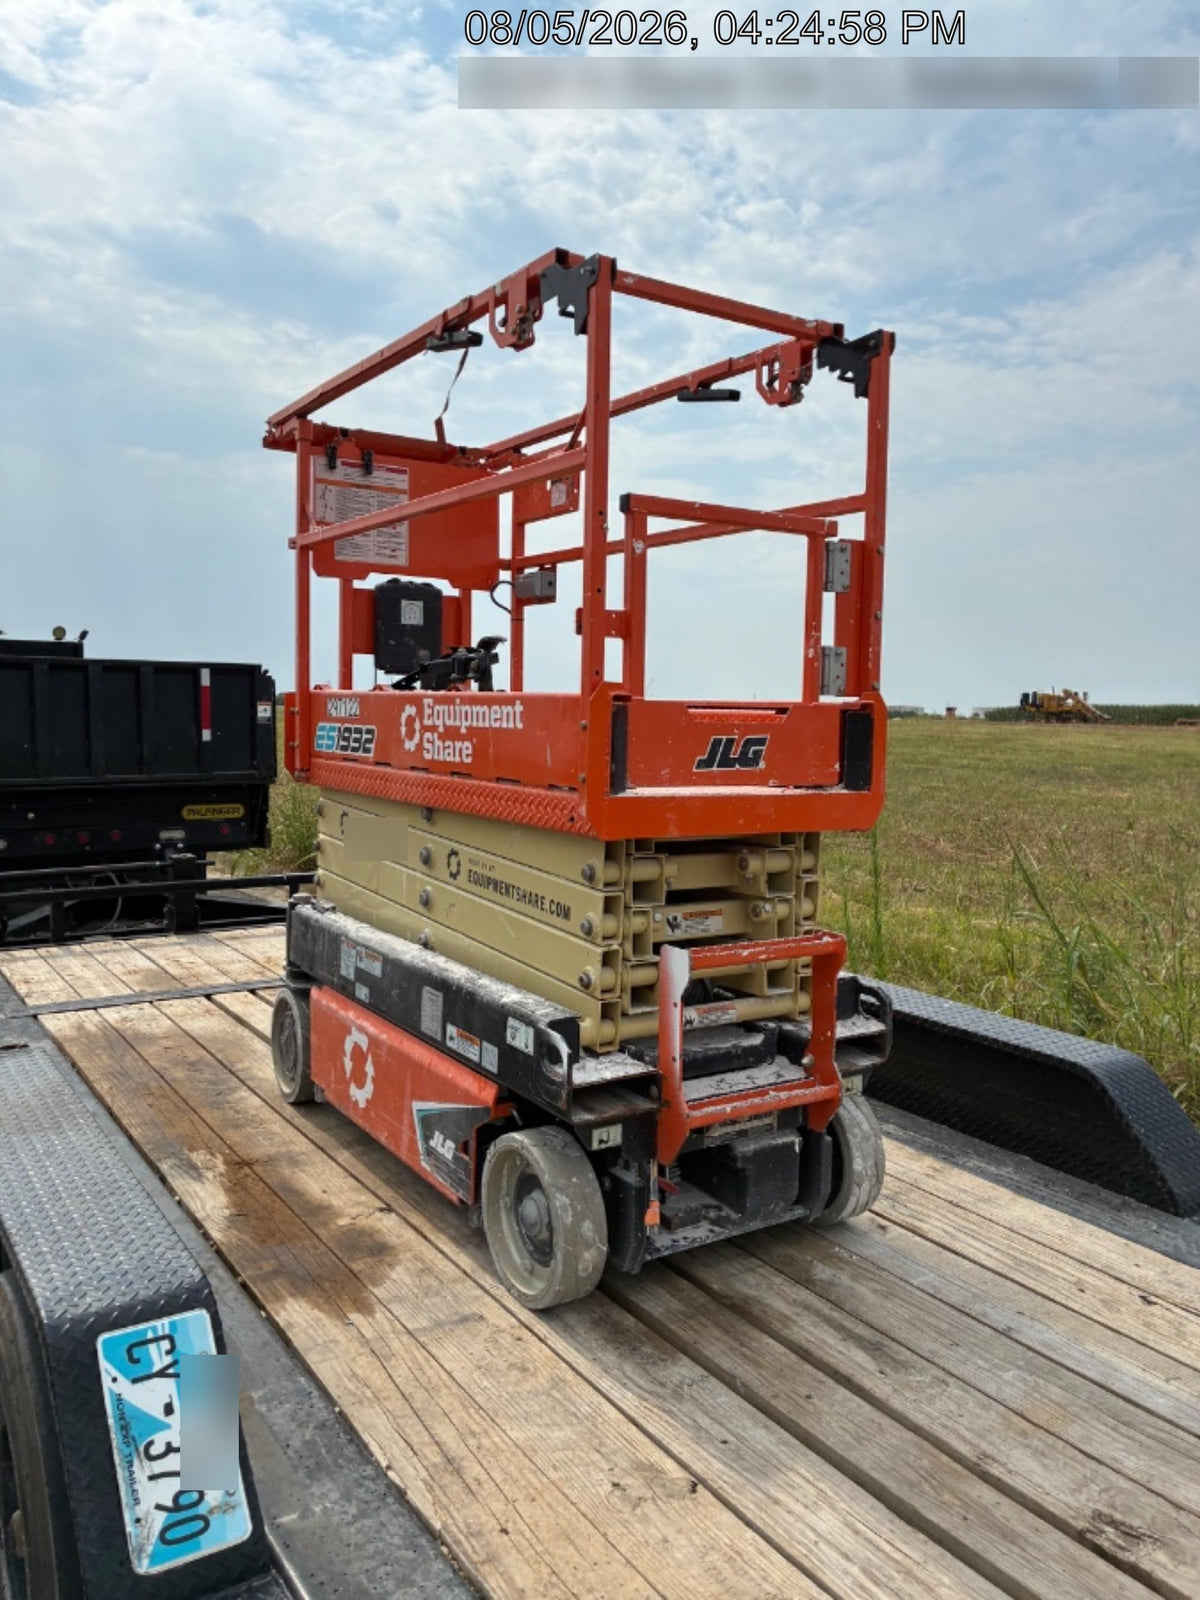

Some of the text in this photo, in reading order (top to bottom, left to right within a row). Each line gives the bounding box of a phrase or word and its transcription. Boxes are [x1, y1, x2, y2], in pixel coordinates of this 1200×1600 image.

[423, 698, 524, 734] Equipment
[422, 732, 473, 764] Share
[693, 735, 769, 771] JLG
[468, 869, 571, 921] EQUIPMENTSHARE.COM
